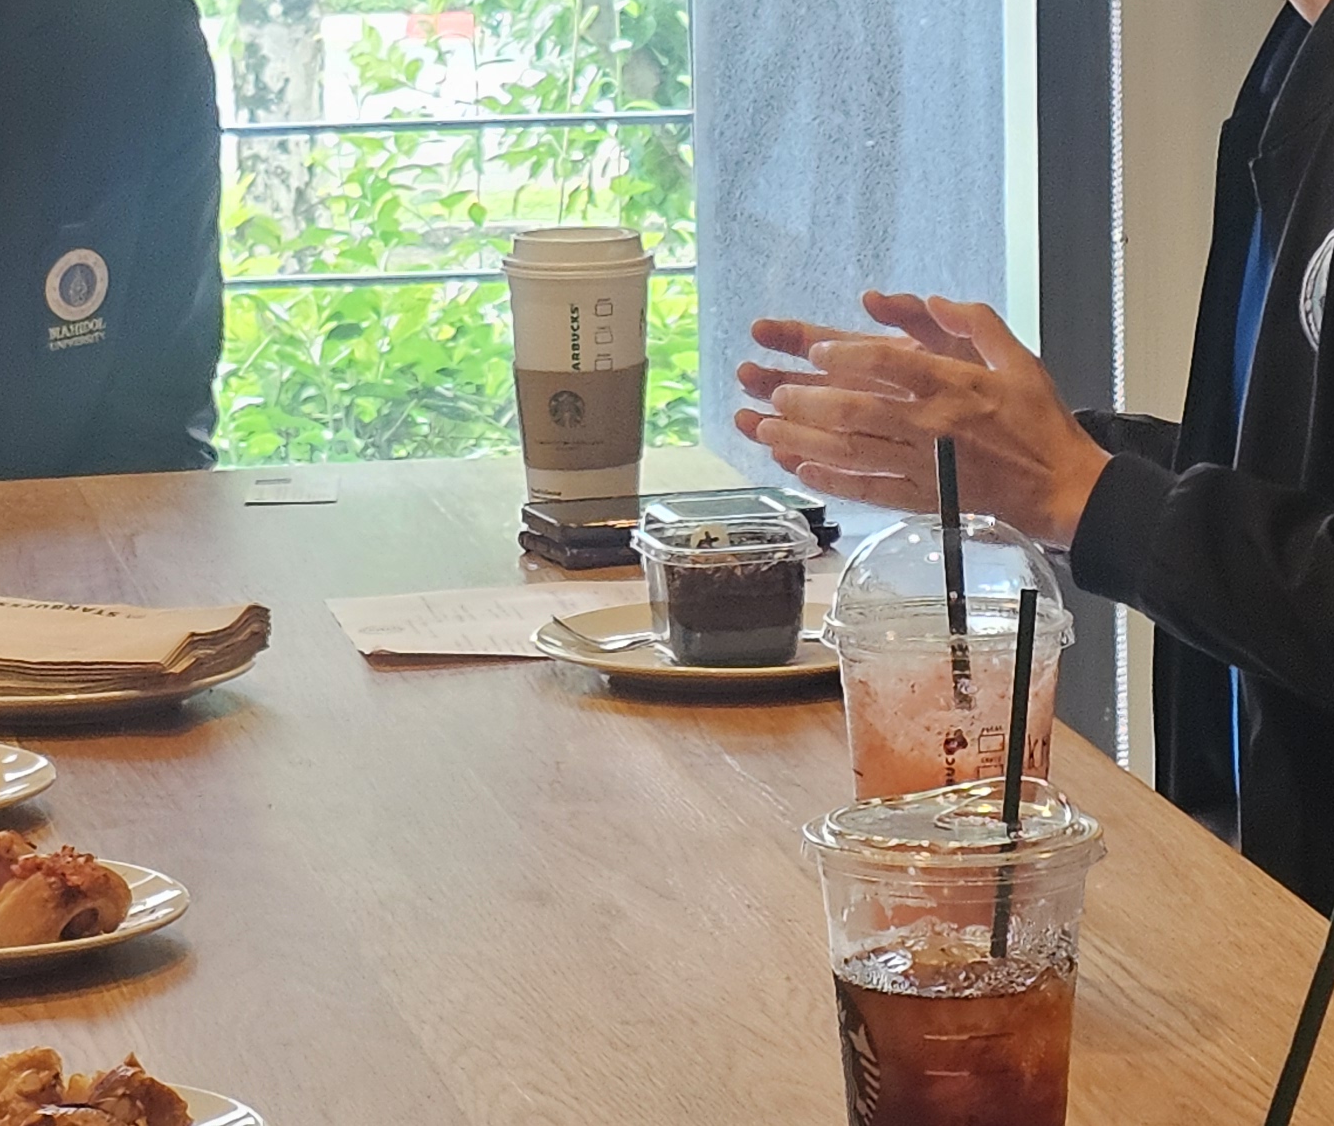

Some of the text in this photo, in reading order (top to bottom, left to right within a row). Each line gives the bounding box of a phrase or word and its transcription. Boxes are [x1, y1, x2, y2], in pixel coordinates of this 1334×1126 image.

[48, 317, 107, 340] MAHIDOL
[570, 303, 581, 371] ARBUCKS
[48, 331, 107, 352] UNIVERSITY
